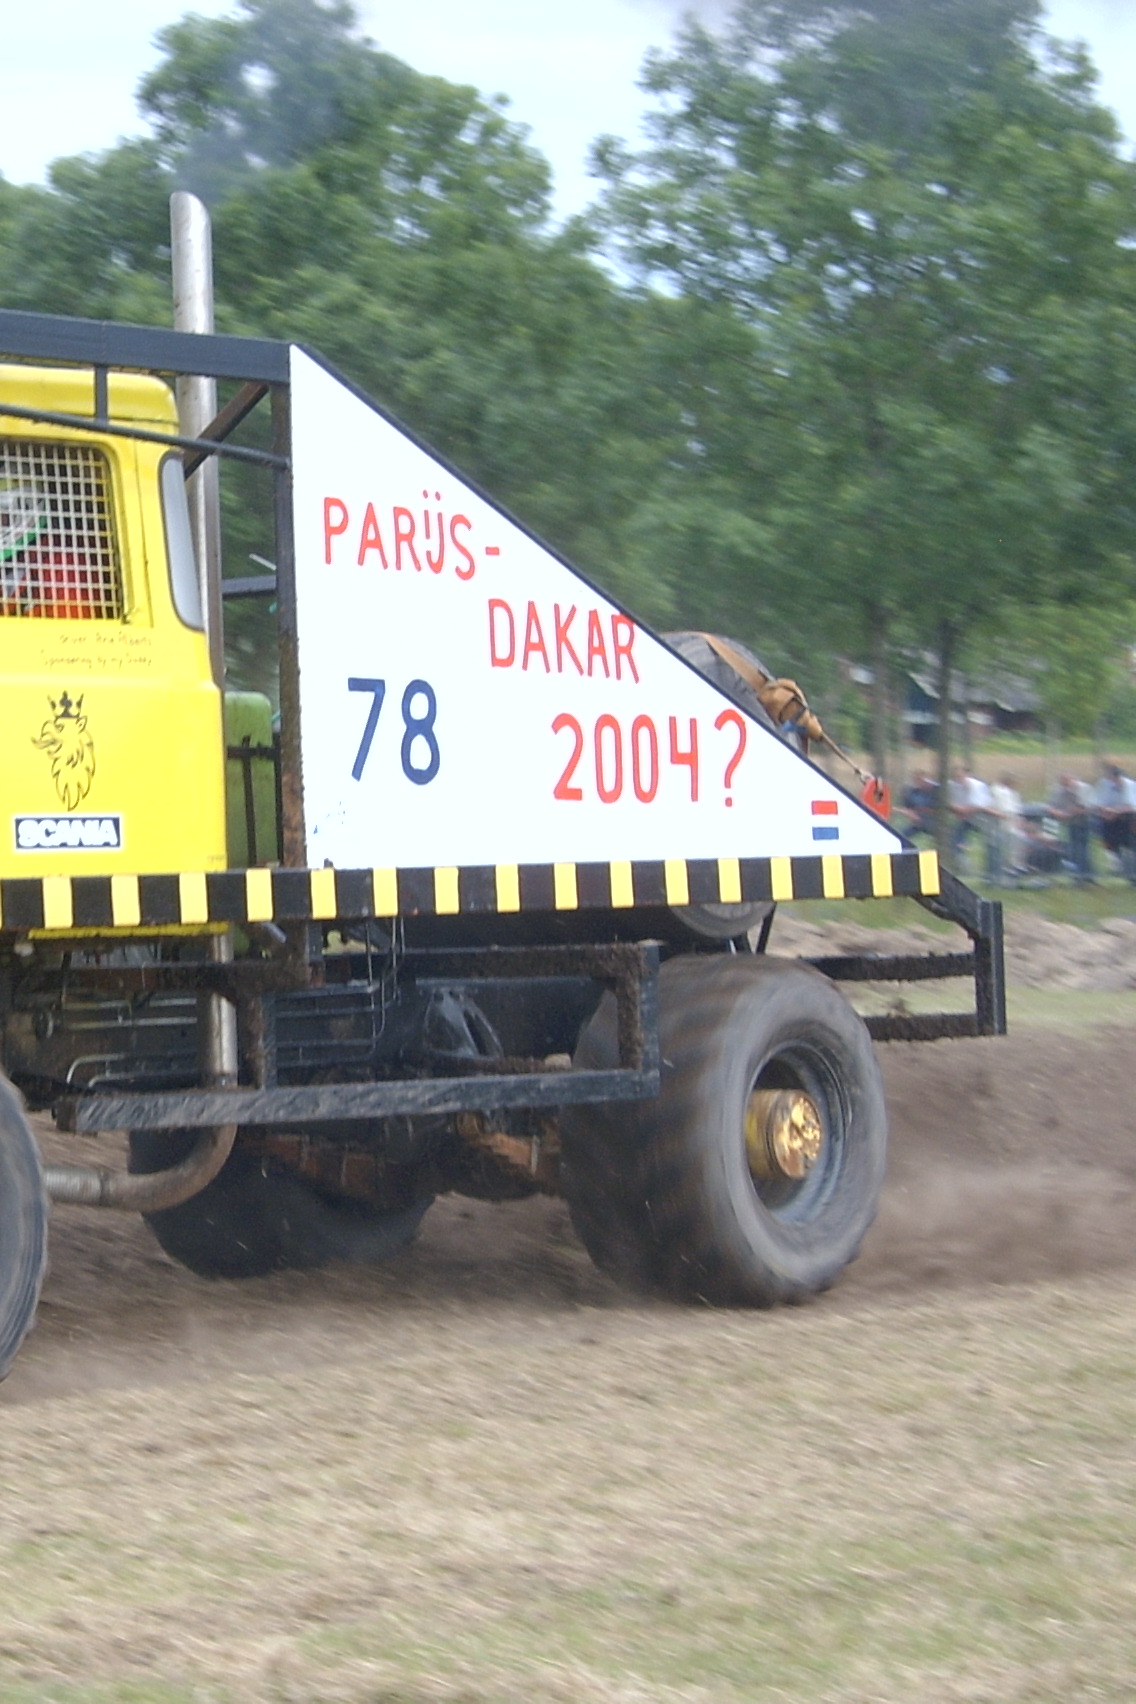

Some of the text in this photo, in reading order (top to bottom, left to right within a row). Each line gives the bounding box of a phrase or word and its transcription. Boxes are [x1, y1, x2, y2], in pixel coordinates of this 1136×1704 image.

[488, 598, 639, 684] DAKAR
[347, 676, 441, 786] 78
[551, 709, 747, 807] 2004?
[17, 818, 118, 847] SCANIA
